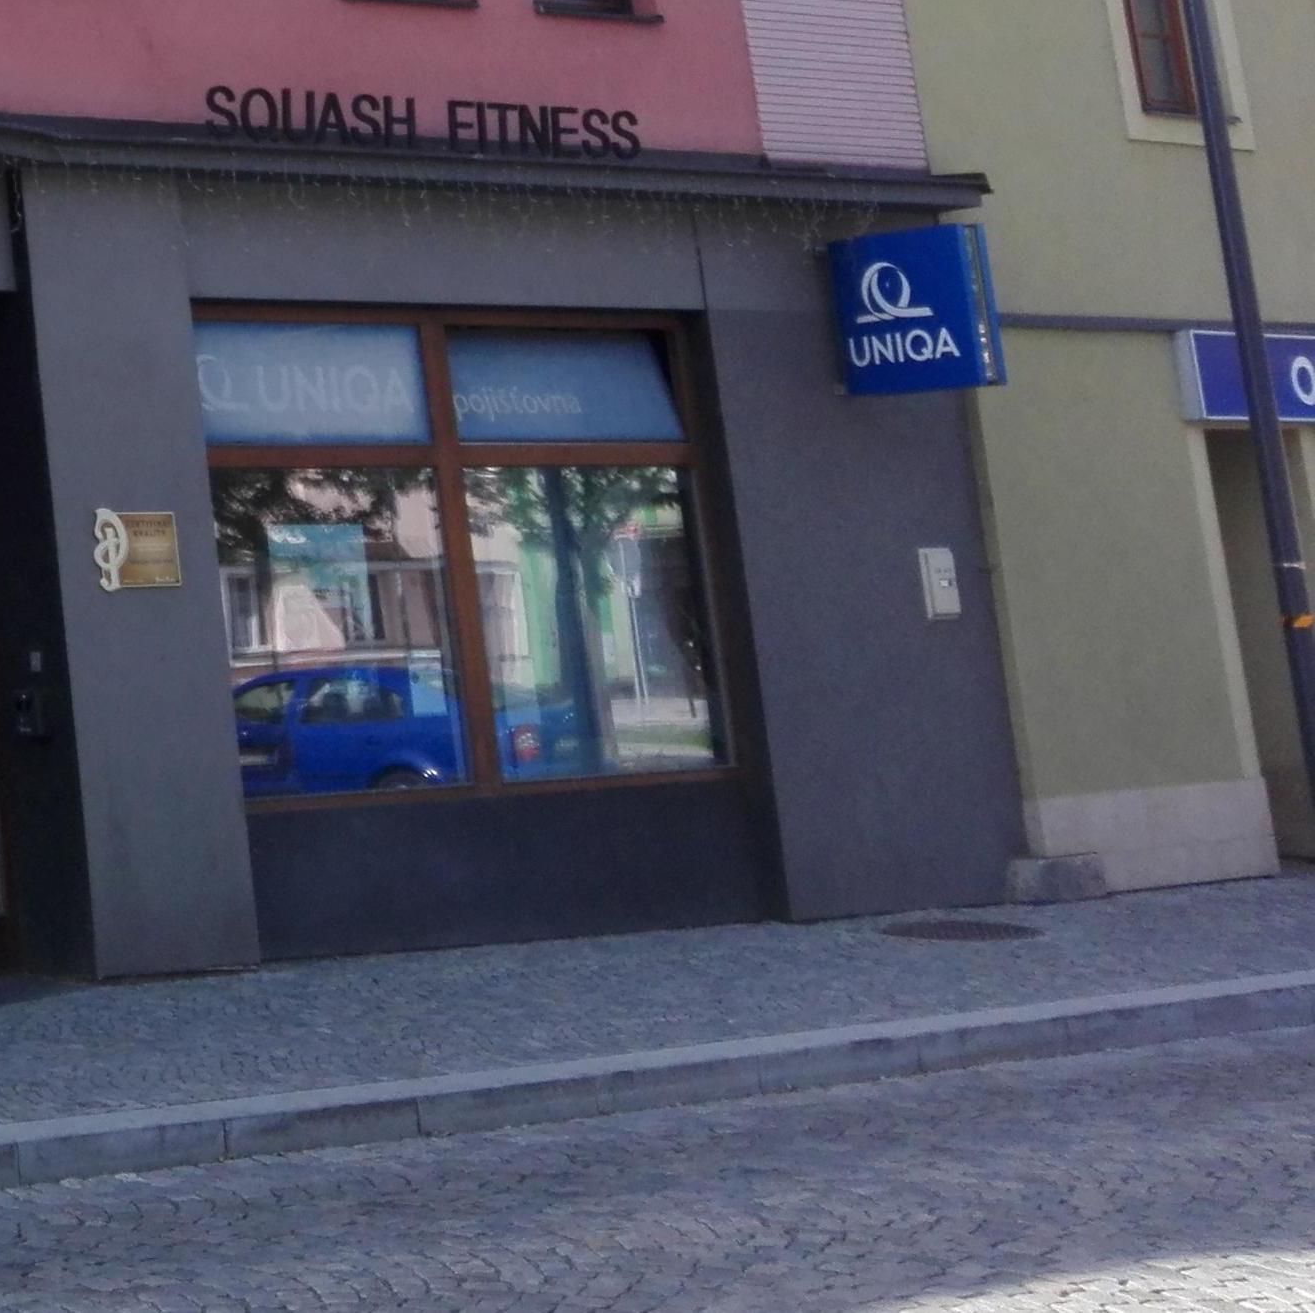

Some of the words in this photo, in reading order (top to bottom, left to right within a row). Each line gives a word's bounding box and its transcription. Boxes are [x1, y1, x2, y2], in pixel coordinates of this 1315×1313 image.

[205, 86, 416, 147] SQUASH
[446, 100, 641, 160] FITNESS
[849, 327, 960, 367] UNIQA
[258, 364, 414, 413] UNIQA
